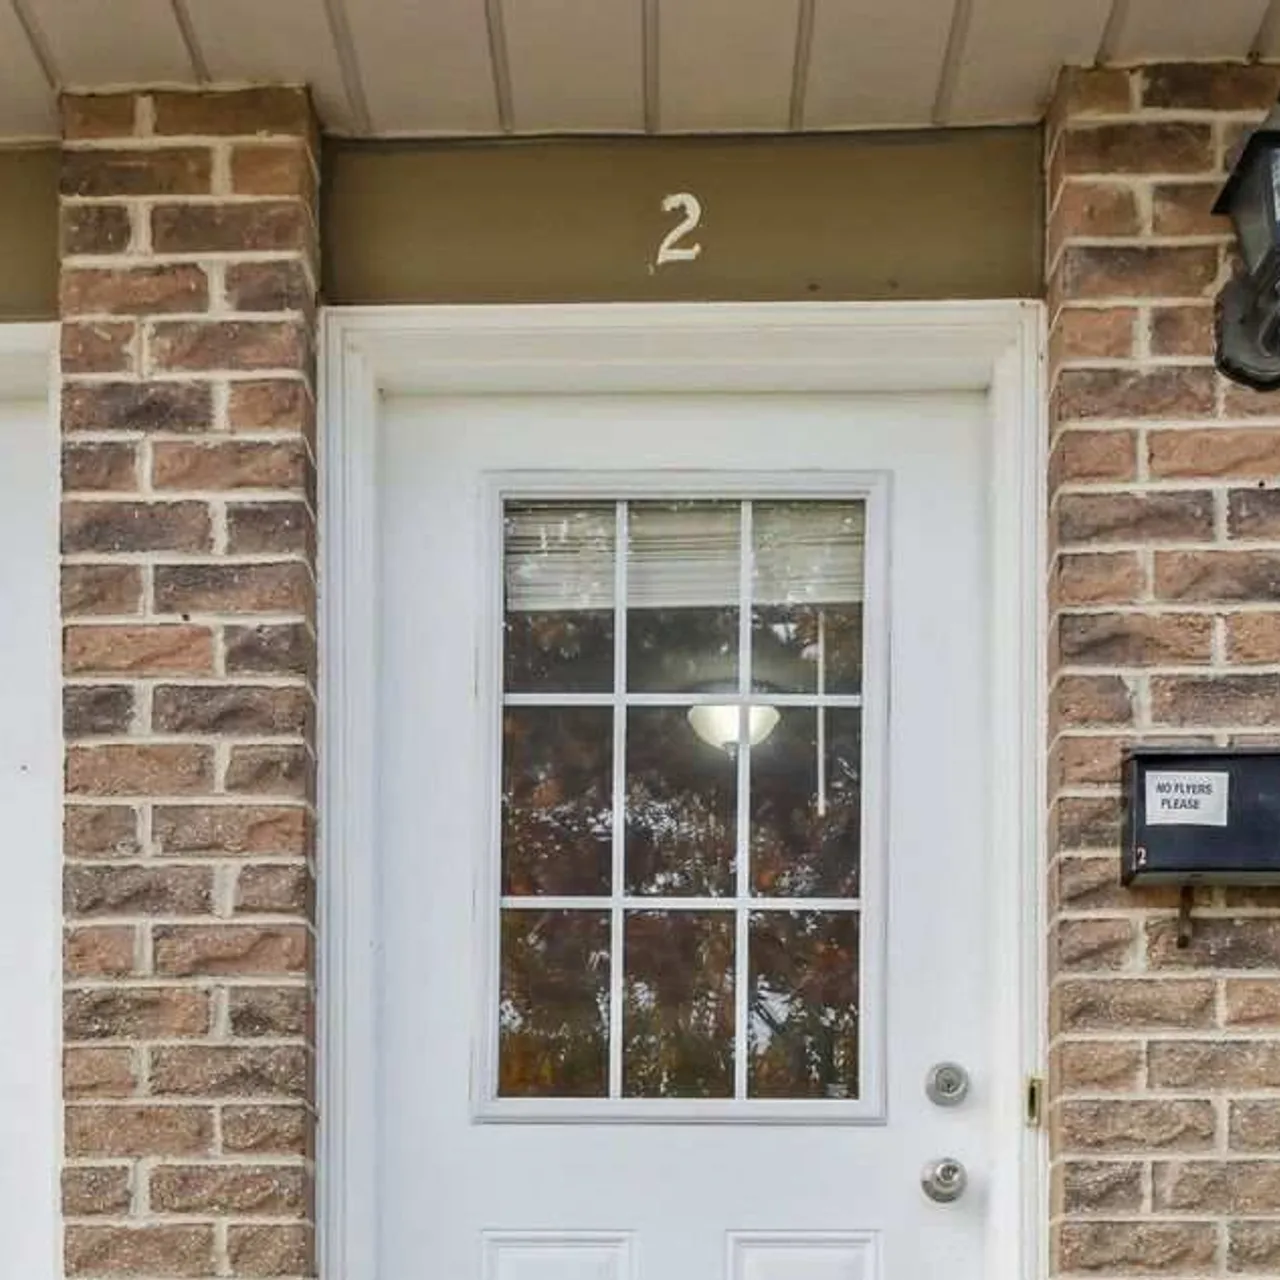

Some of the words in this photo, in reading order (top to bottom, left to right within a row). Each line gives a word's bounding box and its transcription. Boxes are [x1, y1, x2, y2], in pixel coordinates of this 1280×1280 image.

[656, 192, 701, 265] 2
[1156, 782, 1172, 793] NO
[1174, 783, 1213, 795] FLYERS
[1161, 798, 1199, 810] PLEASE
[1137, 847, 1147, 865] 2
